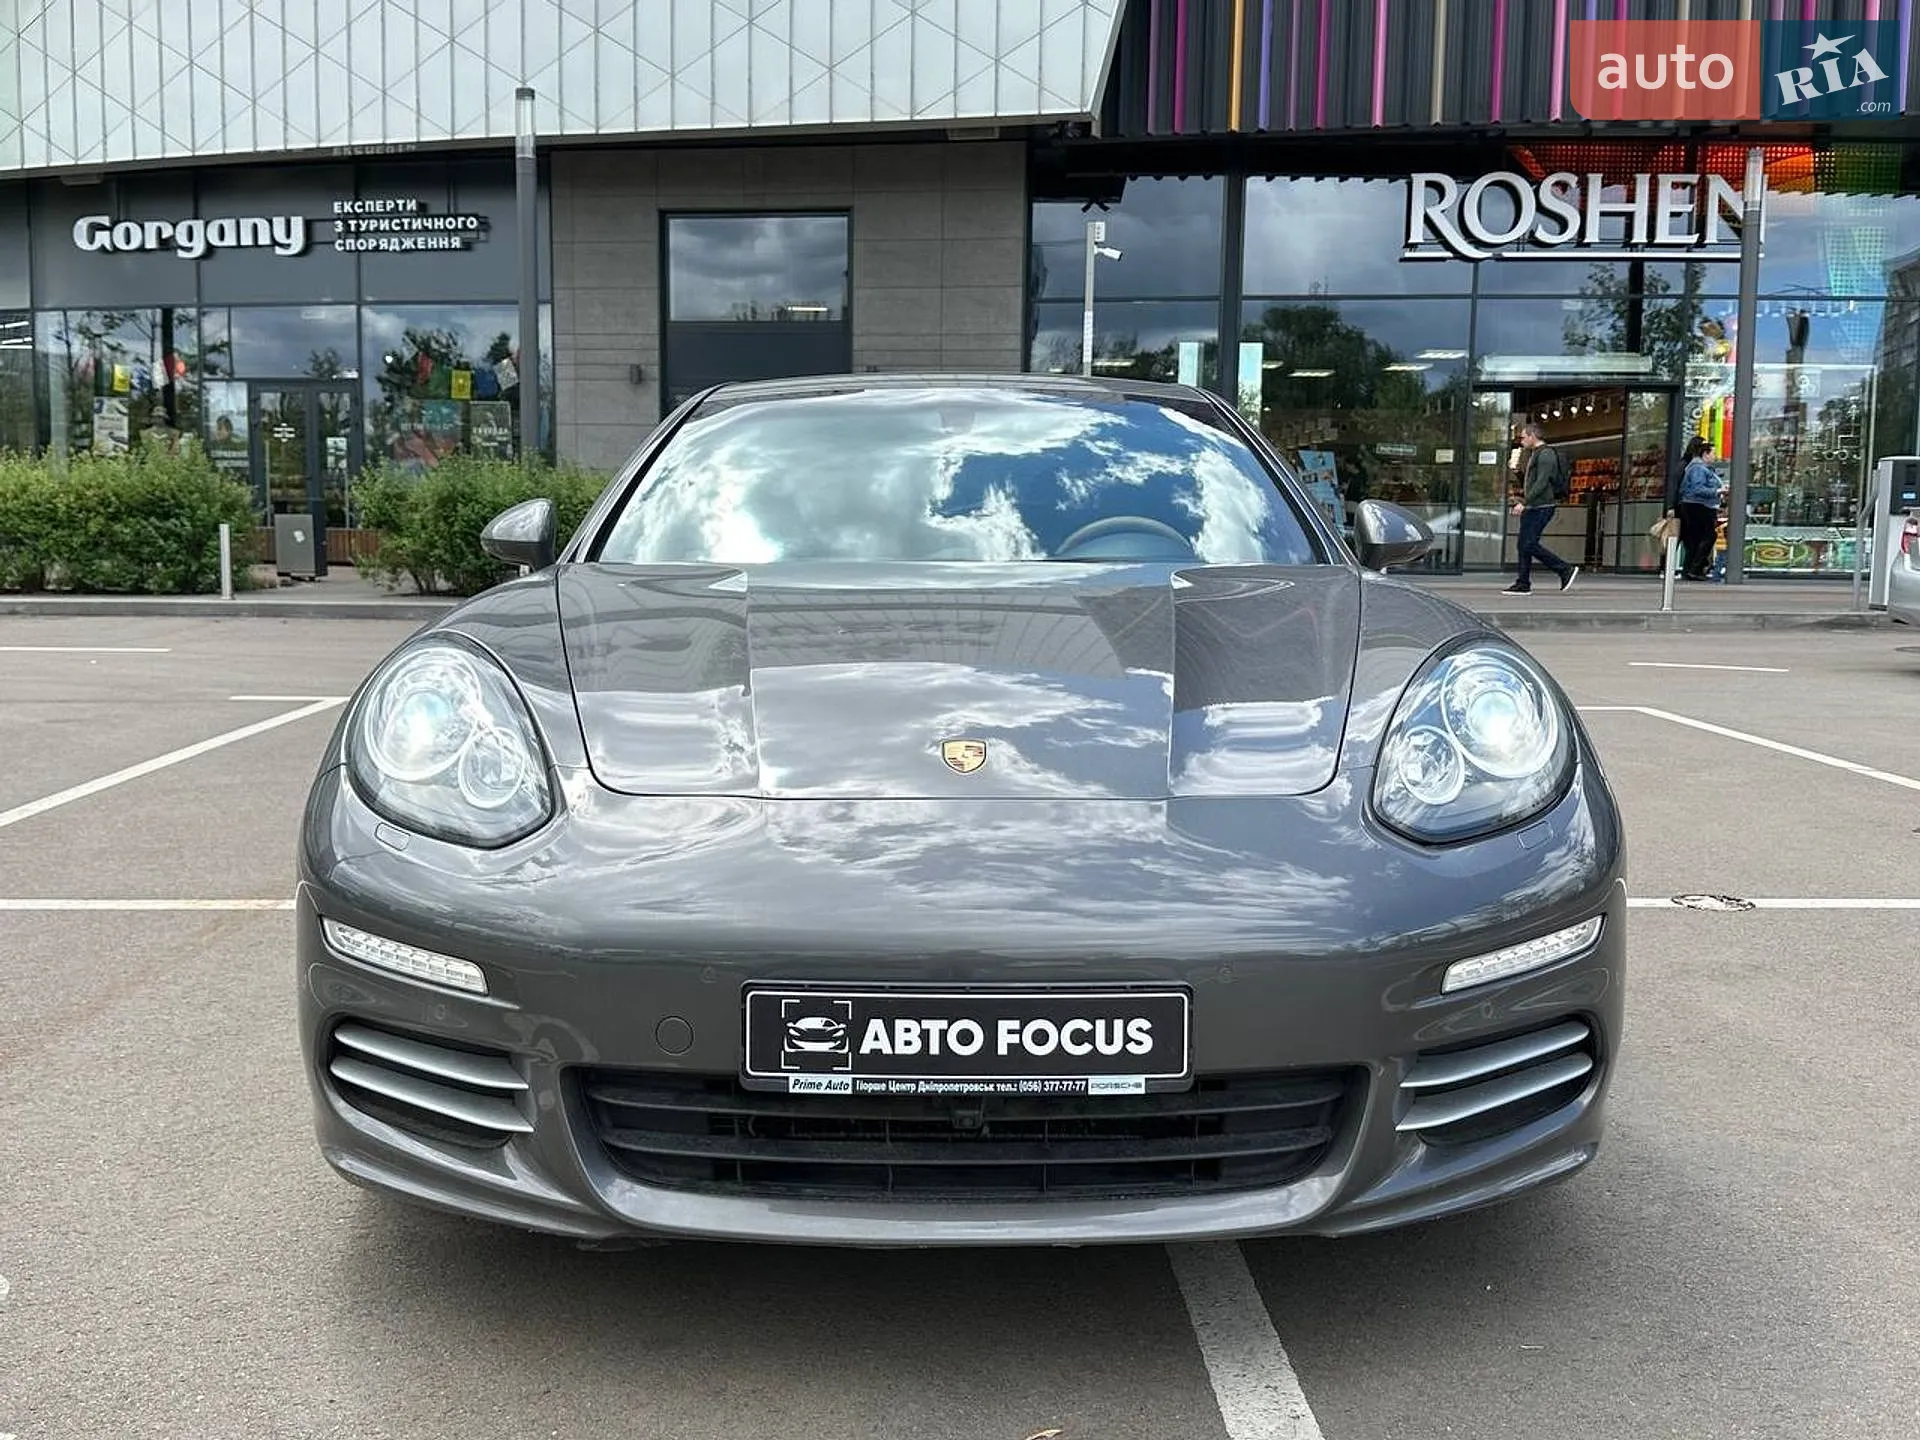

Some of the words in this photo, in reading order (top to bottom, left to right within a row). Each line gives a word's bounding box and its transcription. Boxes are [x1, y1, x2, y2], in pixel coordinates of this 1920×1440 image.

[333, 200, 417, 214] ЕКСПЕРТИ
[1405, 172, 1766, 260] ROSHEN
[349, 217, 479, 232] ТУРИСТИЧНОГО
[73, 215, 306, 258] Gorgany
[335, 237, 462, 252] СПОРЯДЖЕННЯ
[859, 1019, 984, 1056] АВТО
[997, 1018, 1153, 1055] FOCUS
[792, 1079, 822, 1090] Prime
[825, 1080, 850, 1091] Auto
[889, 1081, 917, 1094] Центр
[1043, 1080, 1086, 1093] 377-77-77
